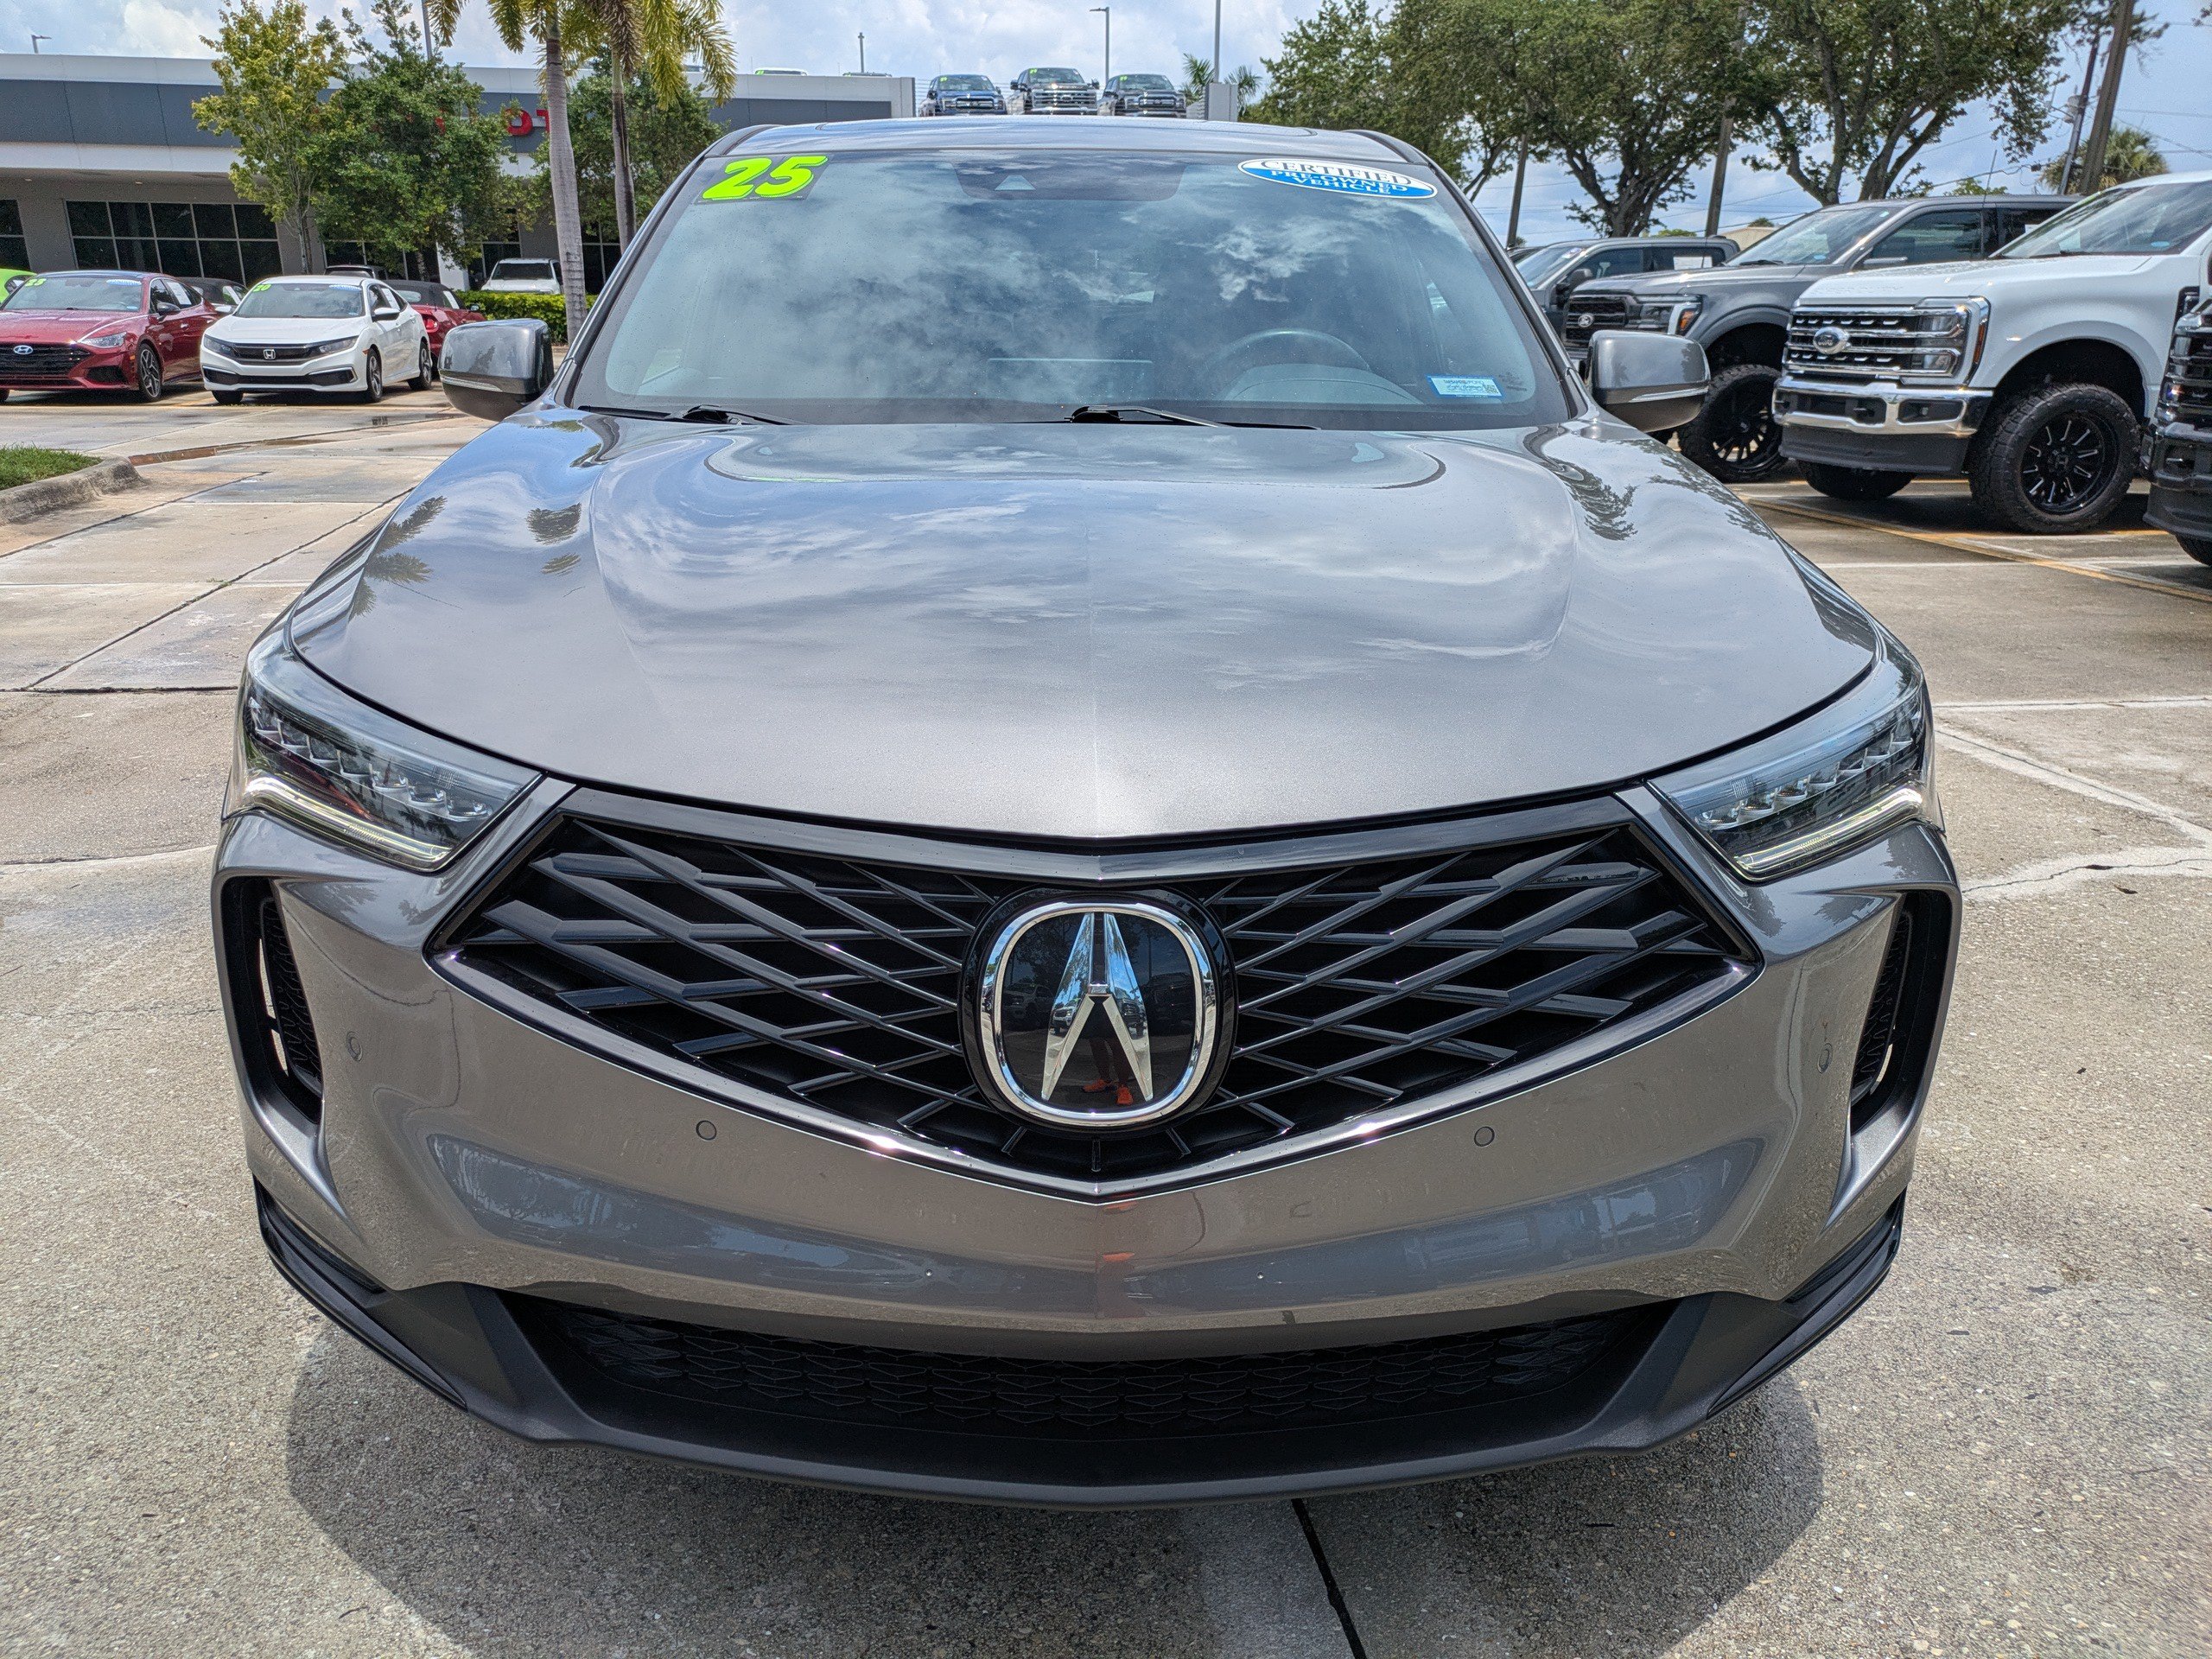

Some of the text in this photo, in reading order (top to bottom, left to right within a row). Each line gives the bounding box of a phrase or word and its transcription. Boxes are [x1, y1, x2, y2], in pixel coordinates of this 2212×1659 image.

[702, 156, 829, 200] 25
[1261, 161, 1412, 185] CERTIFIED
[1271, 169, 1408, 192] PRE-OWNED
[1293, 177, 1392, 194] VEHICLE
